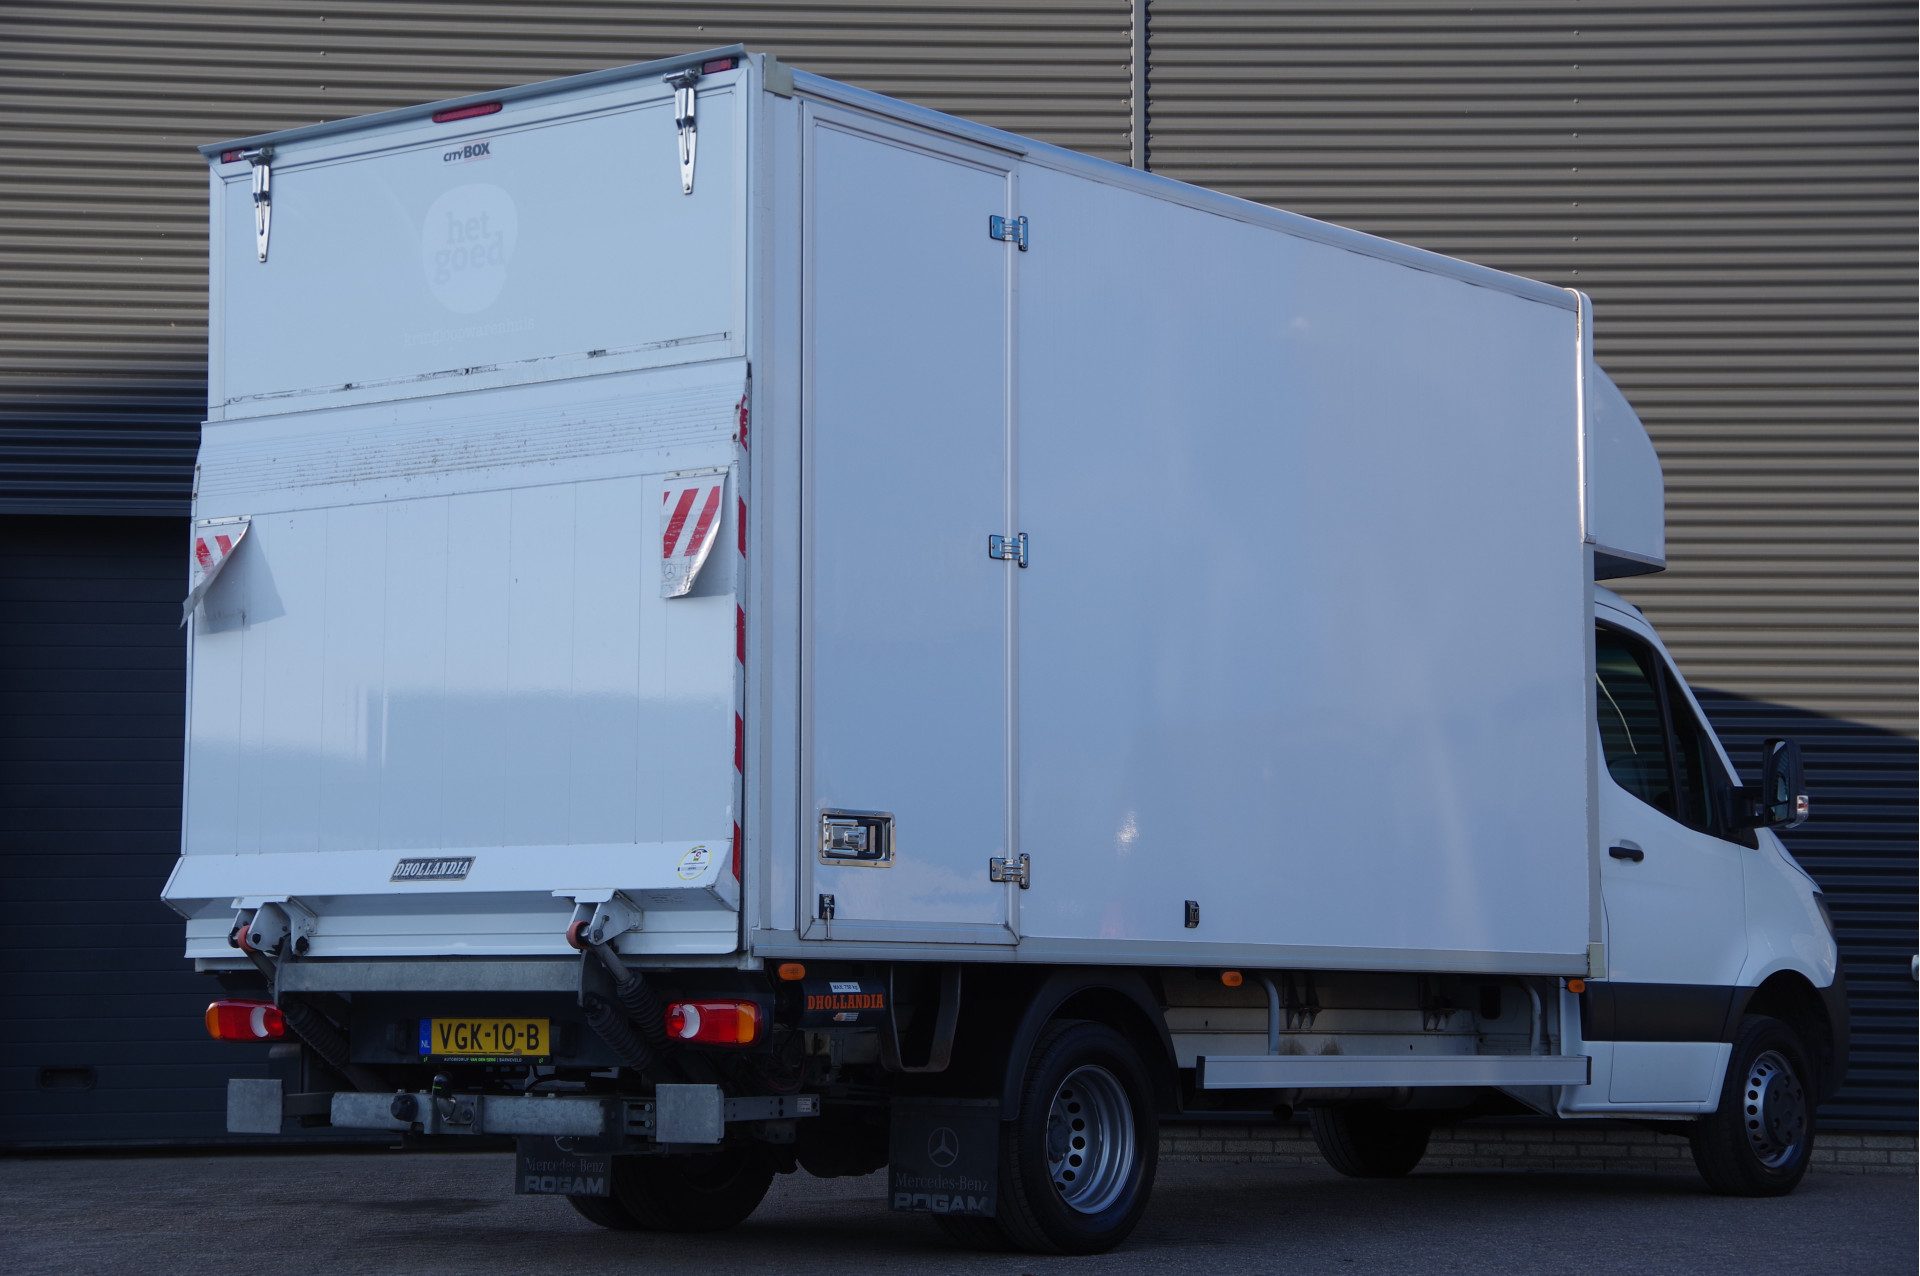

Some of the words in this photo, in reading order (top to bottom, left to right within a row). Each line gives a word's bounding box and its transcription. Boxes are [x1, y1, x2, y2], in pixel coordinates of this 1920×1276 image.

[446, 211, 490, 243] het
[434, 231, 505, 285] goed
[393, 861, 470, 877] DHOLLANDIA
[808, 994, 883, 1009] DHOLLANDIA
[420, 1040, 430, 1049] NL
[439, 1023, 540, 1051] VGK-10-B
[524, 1175, 604, 1194] ROGAM
[895, 1172, 989, 1192] Mercedes-Benz
